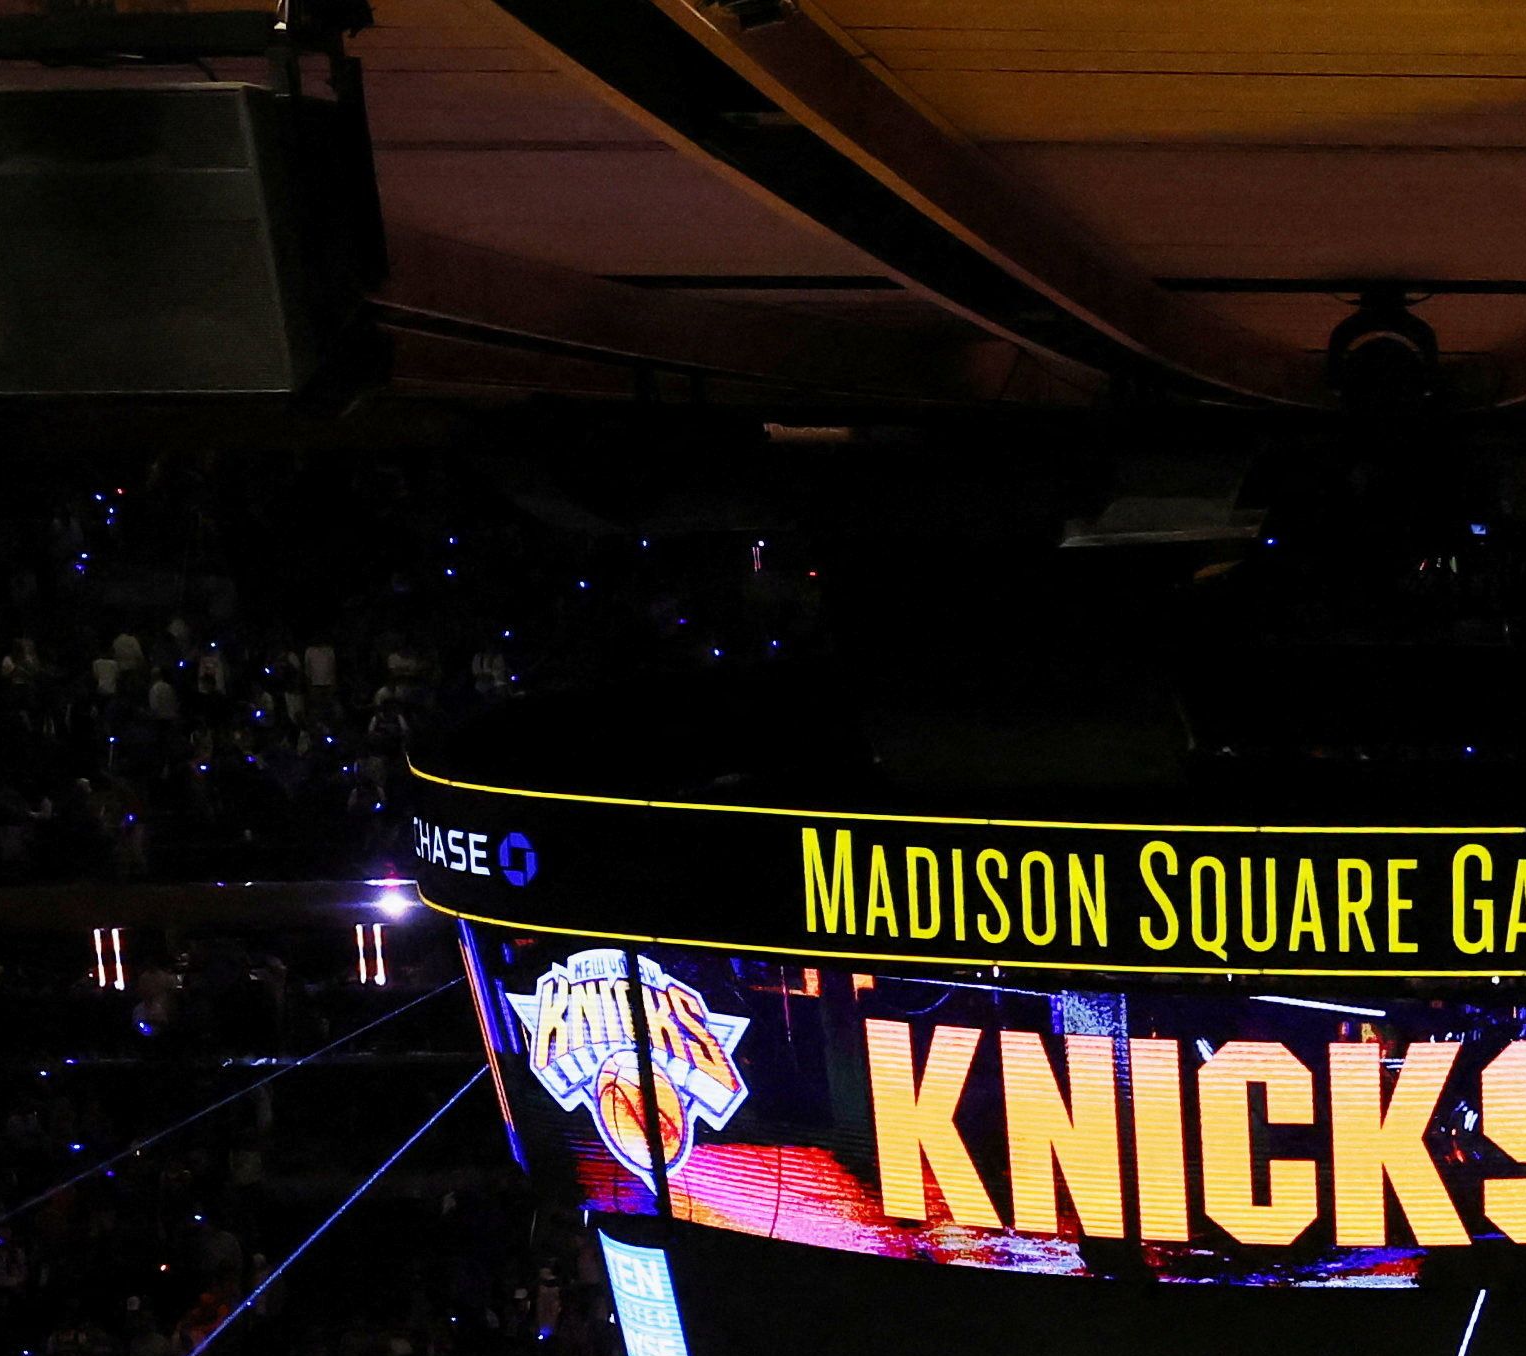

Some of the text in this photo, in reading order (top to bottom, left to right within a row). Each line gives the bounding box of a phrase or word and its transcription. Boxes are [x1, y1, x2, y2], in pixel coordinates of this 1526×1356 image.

[802, 828, 1107, 948] MADISON
[1140, 841, 1418, 962] SQUARE
[536, 976, 740, 1093] KNICKS
